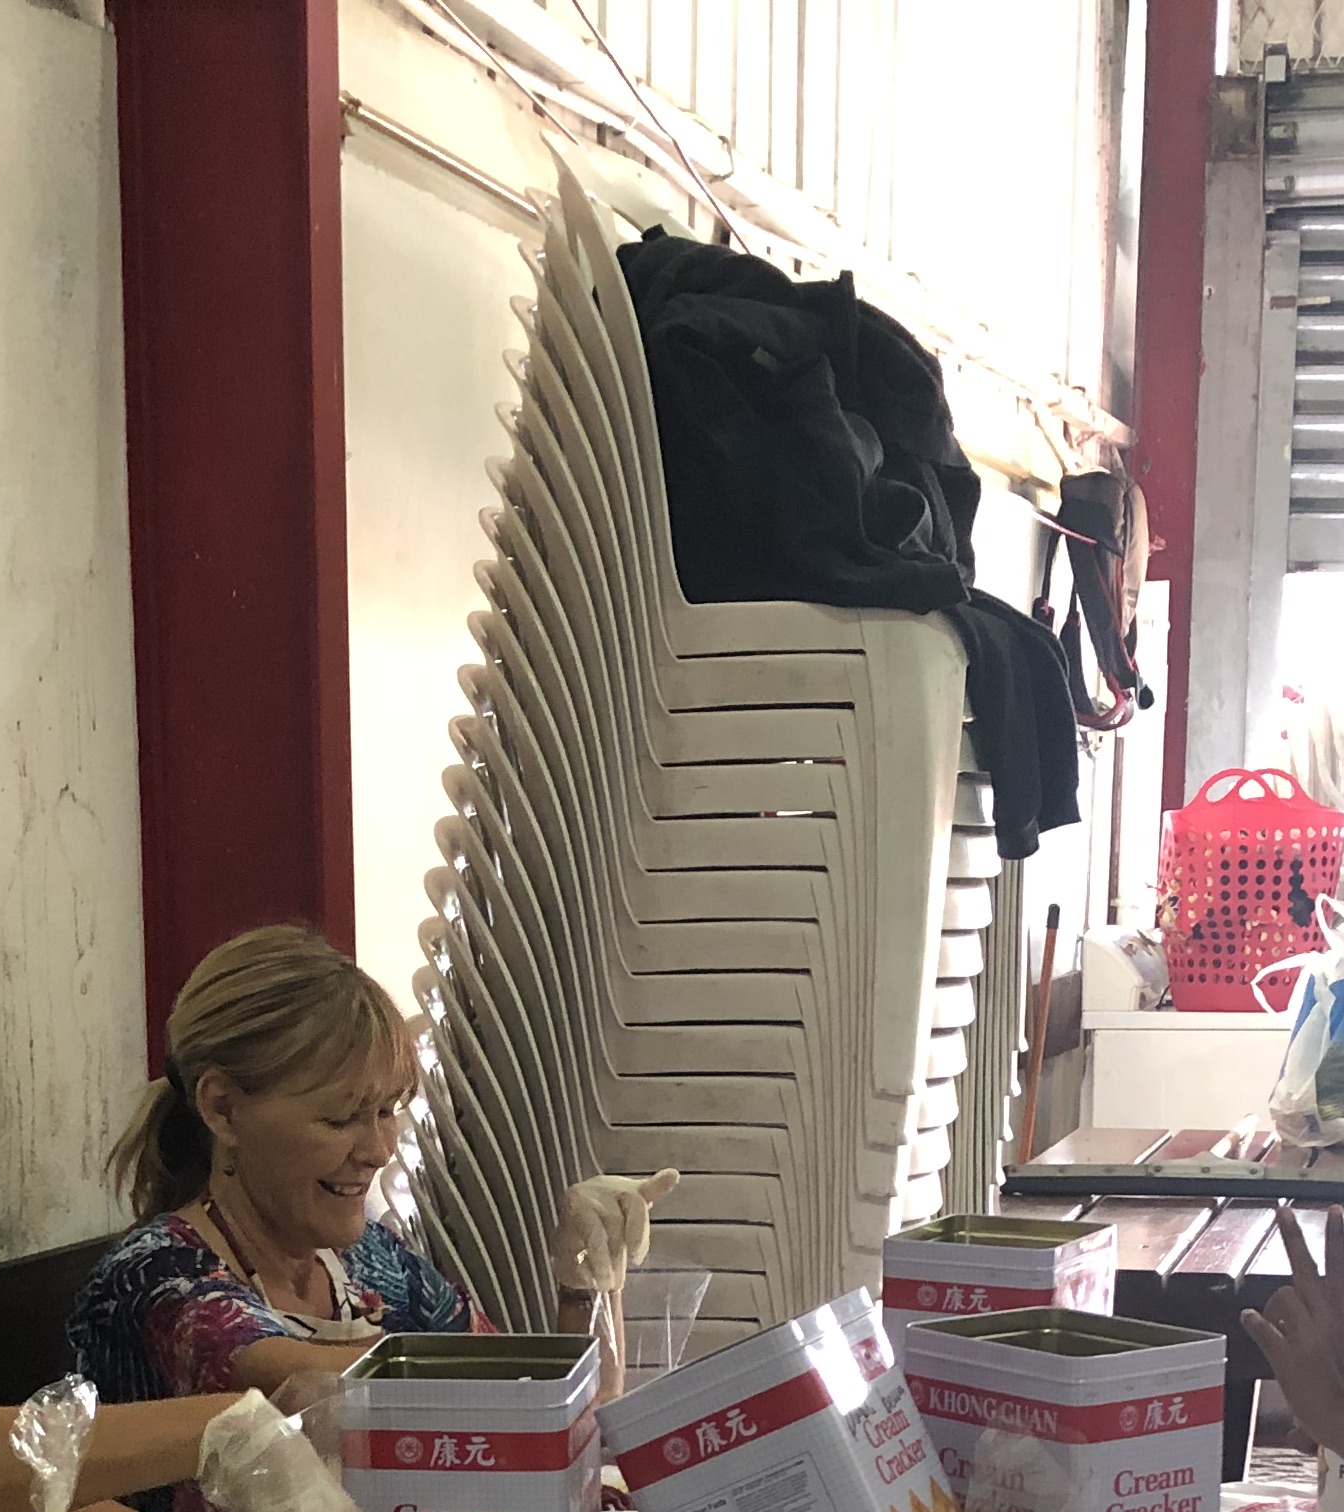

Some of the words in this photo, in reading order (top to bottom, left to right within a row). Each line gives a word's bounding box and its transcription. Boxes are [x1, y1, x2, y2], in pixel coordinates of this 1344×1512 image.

[942, 1286, 991, 1312] 康元
[863, 1409, 911, 1448] Cream
[928, 1386, 997, 1421] KHONG
[1000, 1400, 1058, 1433] GUAN
[1143, 1397, 1189, 1432] 康元
[430, 1434, 495, 1467] 康元
[695, 1408, 757, 1457] 康元
[875, 1439, 926, 1484] Cracker
[939, 1446, 1025, 1491] Crm
[1113, 1466, 1195, 1497] Cream
